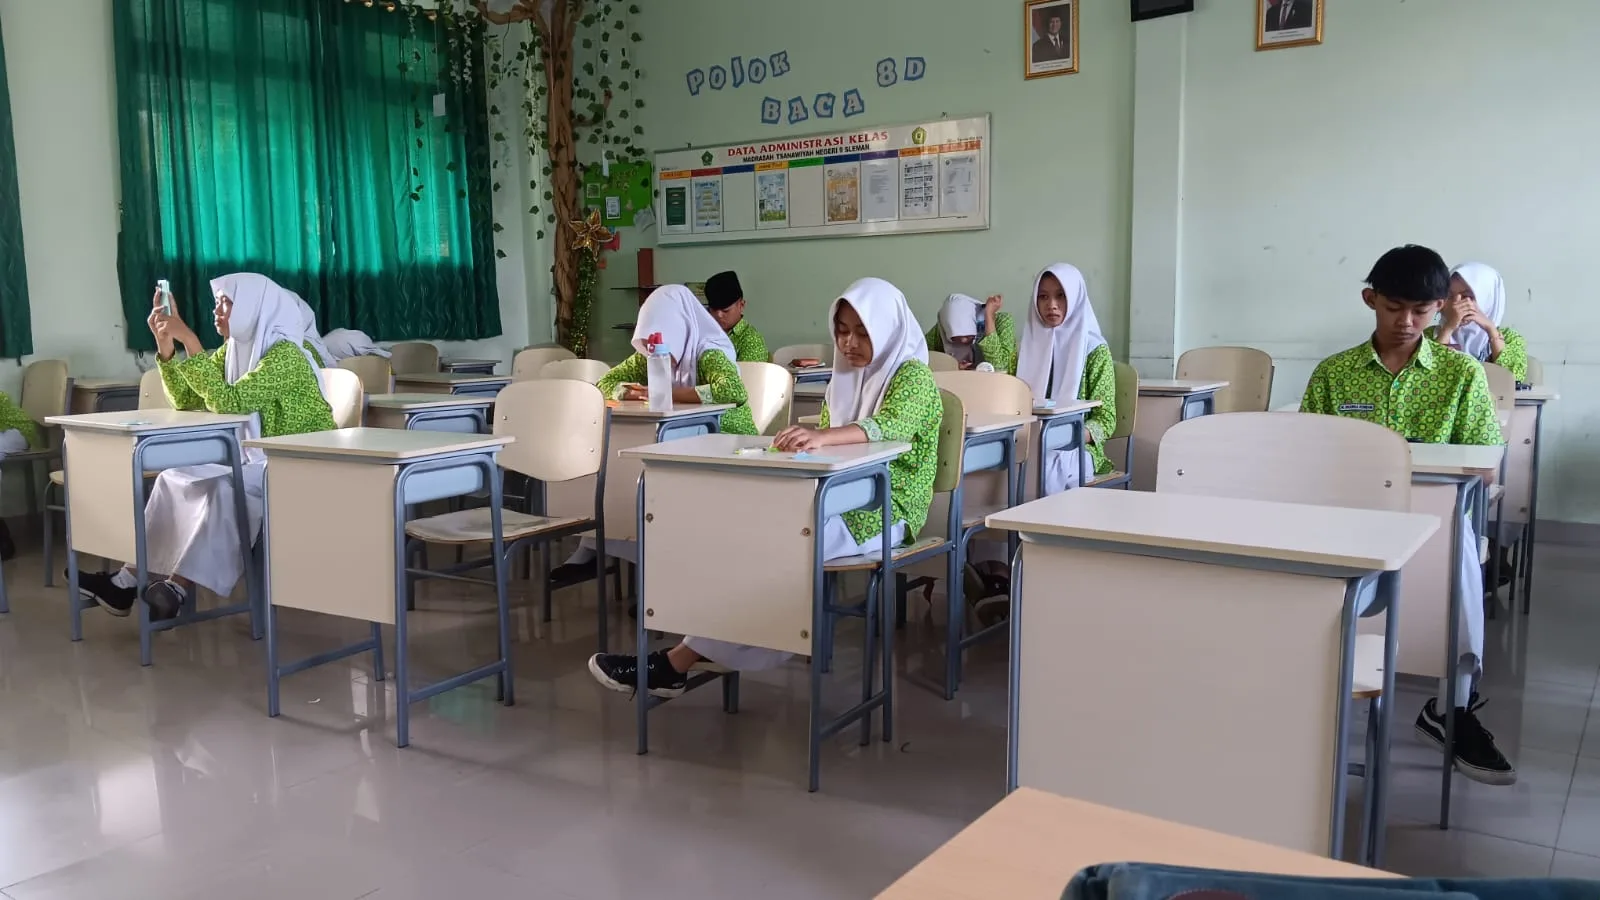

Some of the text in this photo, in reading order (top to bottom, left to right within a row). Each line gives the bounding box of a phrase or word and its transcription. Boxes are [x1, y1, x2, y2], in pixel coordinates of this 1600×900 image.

[686, 50, 790, 96] POJOK
[876, 57, 926, 87] 8D
[761, 88, 864, 124] BACA
[728, 131, 888, 157] DATA ADMINISTRASI KELAS
[743, 154, 774, 163] MADRASAH
[776, 150, 814, 160] TSANAWIYAH
[815, 147, 838, 156] NEGERI
[845, 144, 870, 153] SLEMAN
